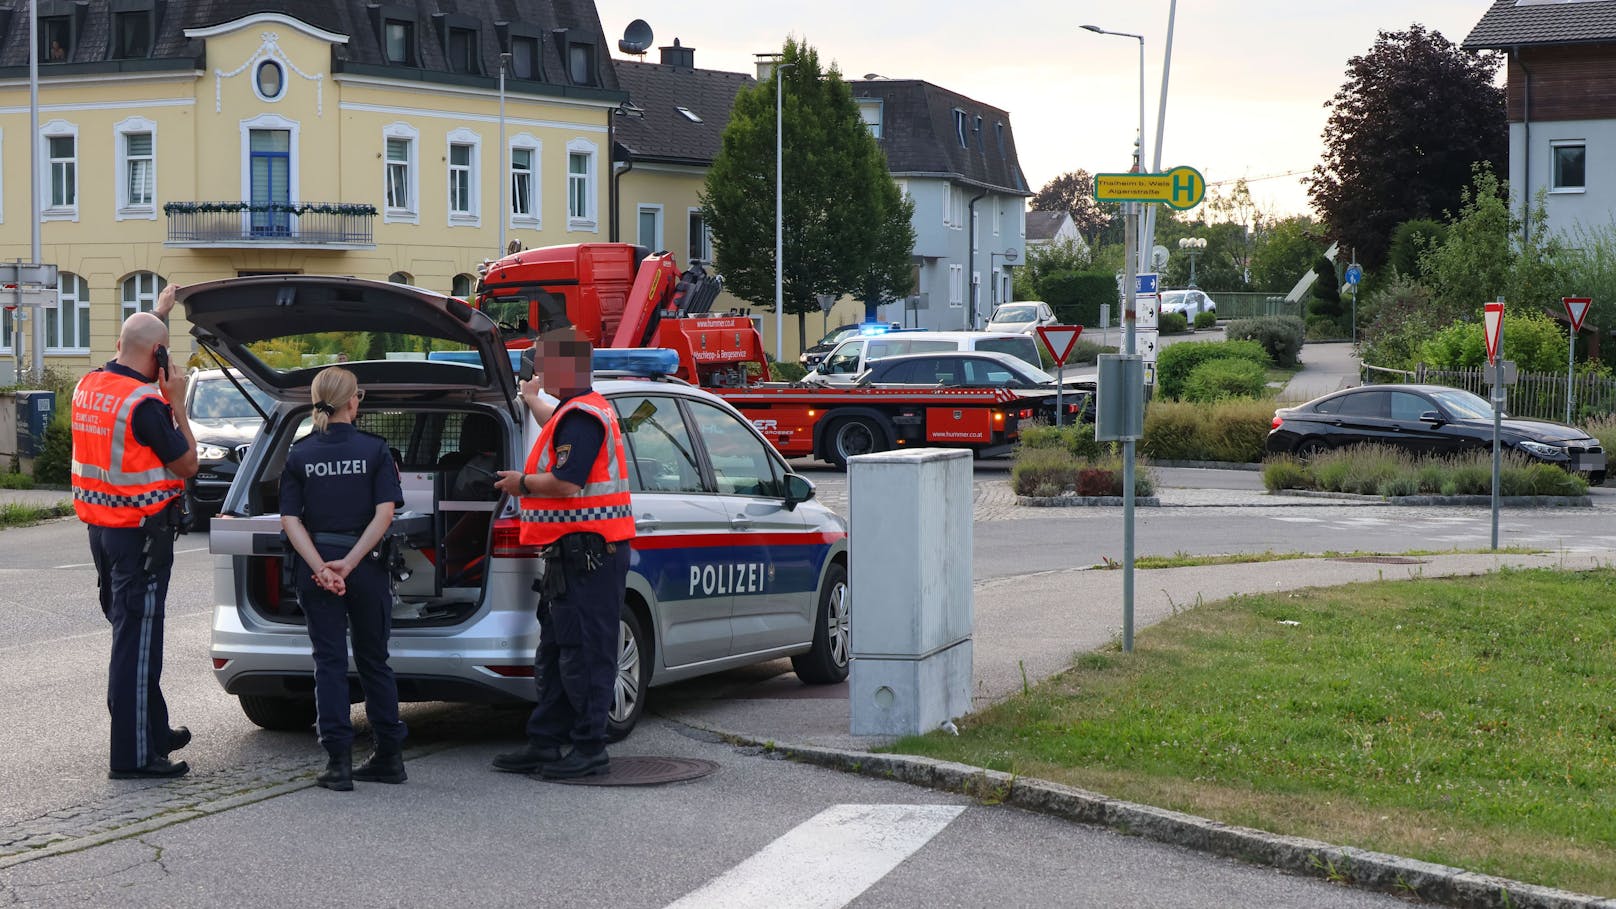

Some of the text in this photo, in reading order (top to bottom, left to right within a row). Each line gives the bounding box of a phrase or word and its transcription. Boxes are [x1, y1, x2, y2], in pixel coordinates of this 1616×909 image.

[1173, 175, 1194, 201] H
[73, 389, 121, 414] POLIZEI
[305, 460, 367, 478] POLIZEI
[689, 563, 765, 596] POLIZEI
